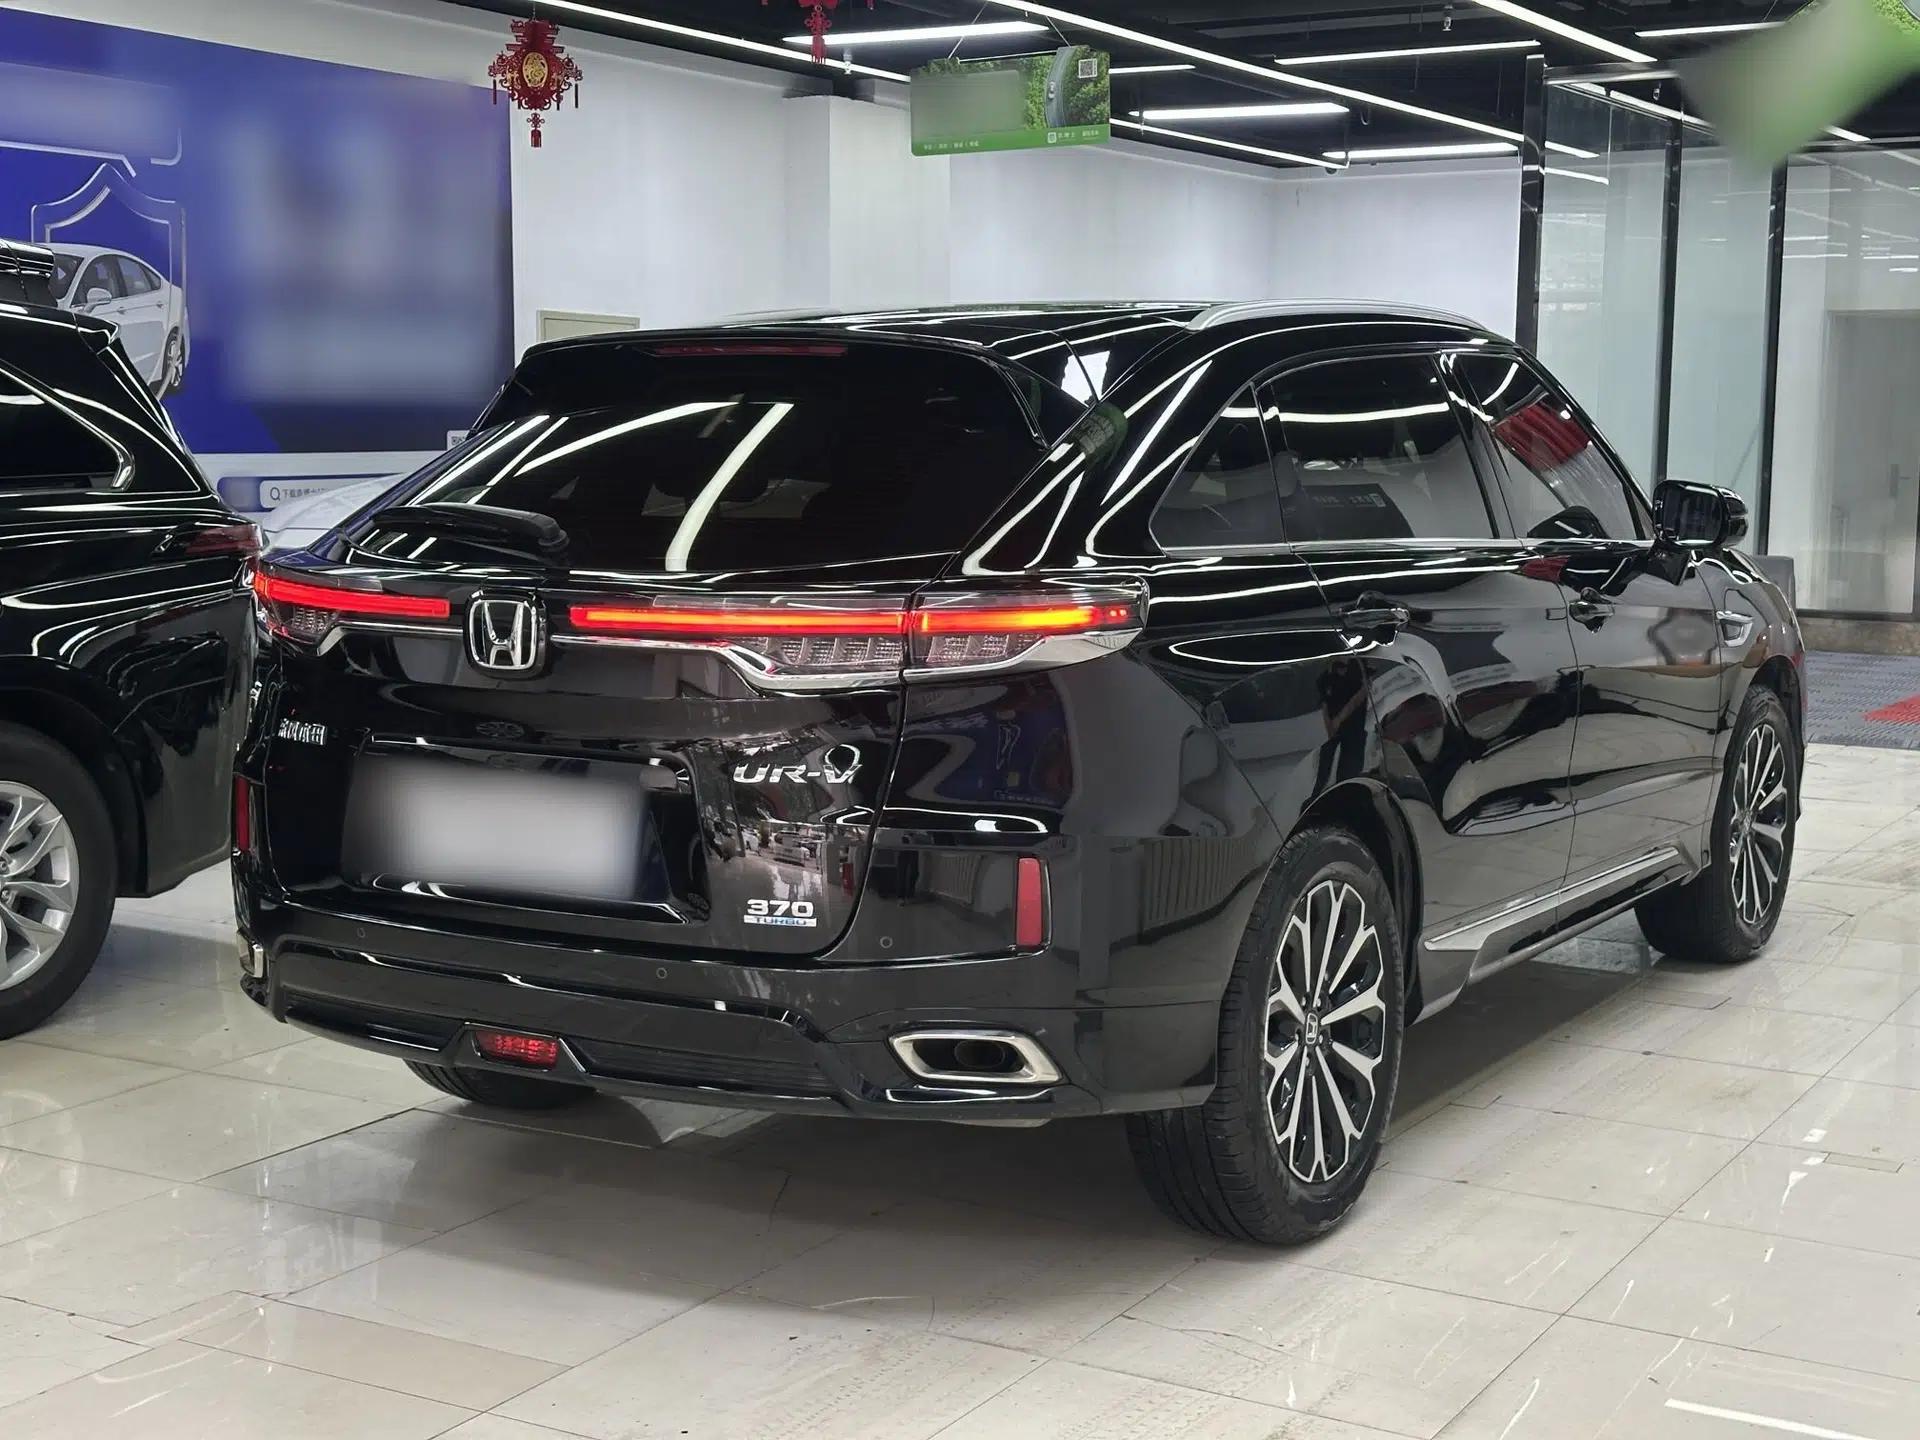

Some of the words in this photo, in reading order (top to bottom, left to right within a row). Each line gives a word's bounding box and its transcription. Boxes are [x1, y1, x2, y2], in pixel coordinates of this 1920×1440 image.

[733, 763, 863, 784] UR-V
[747, 898, 814, 917] 370
[754, 916, 807, 926] TURBO
